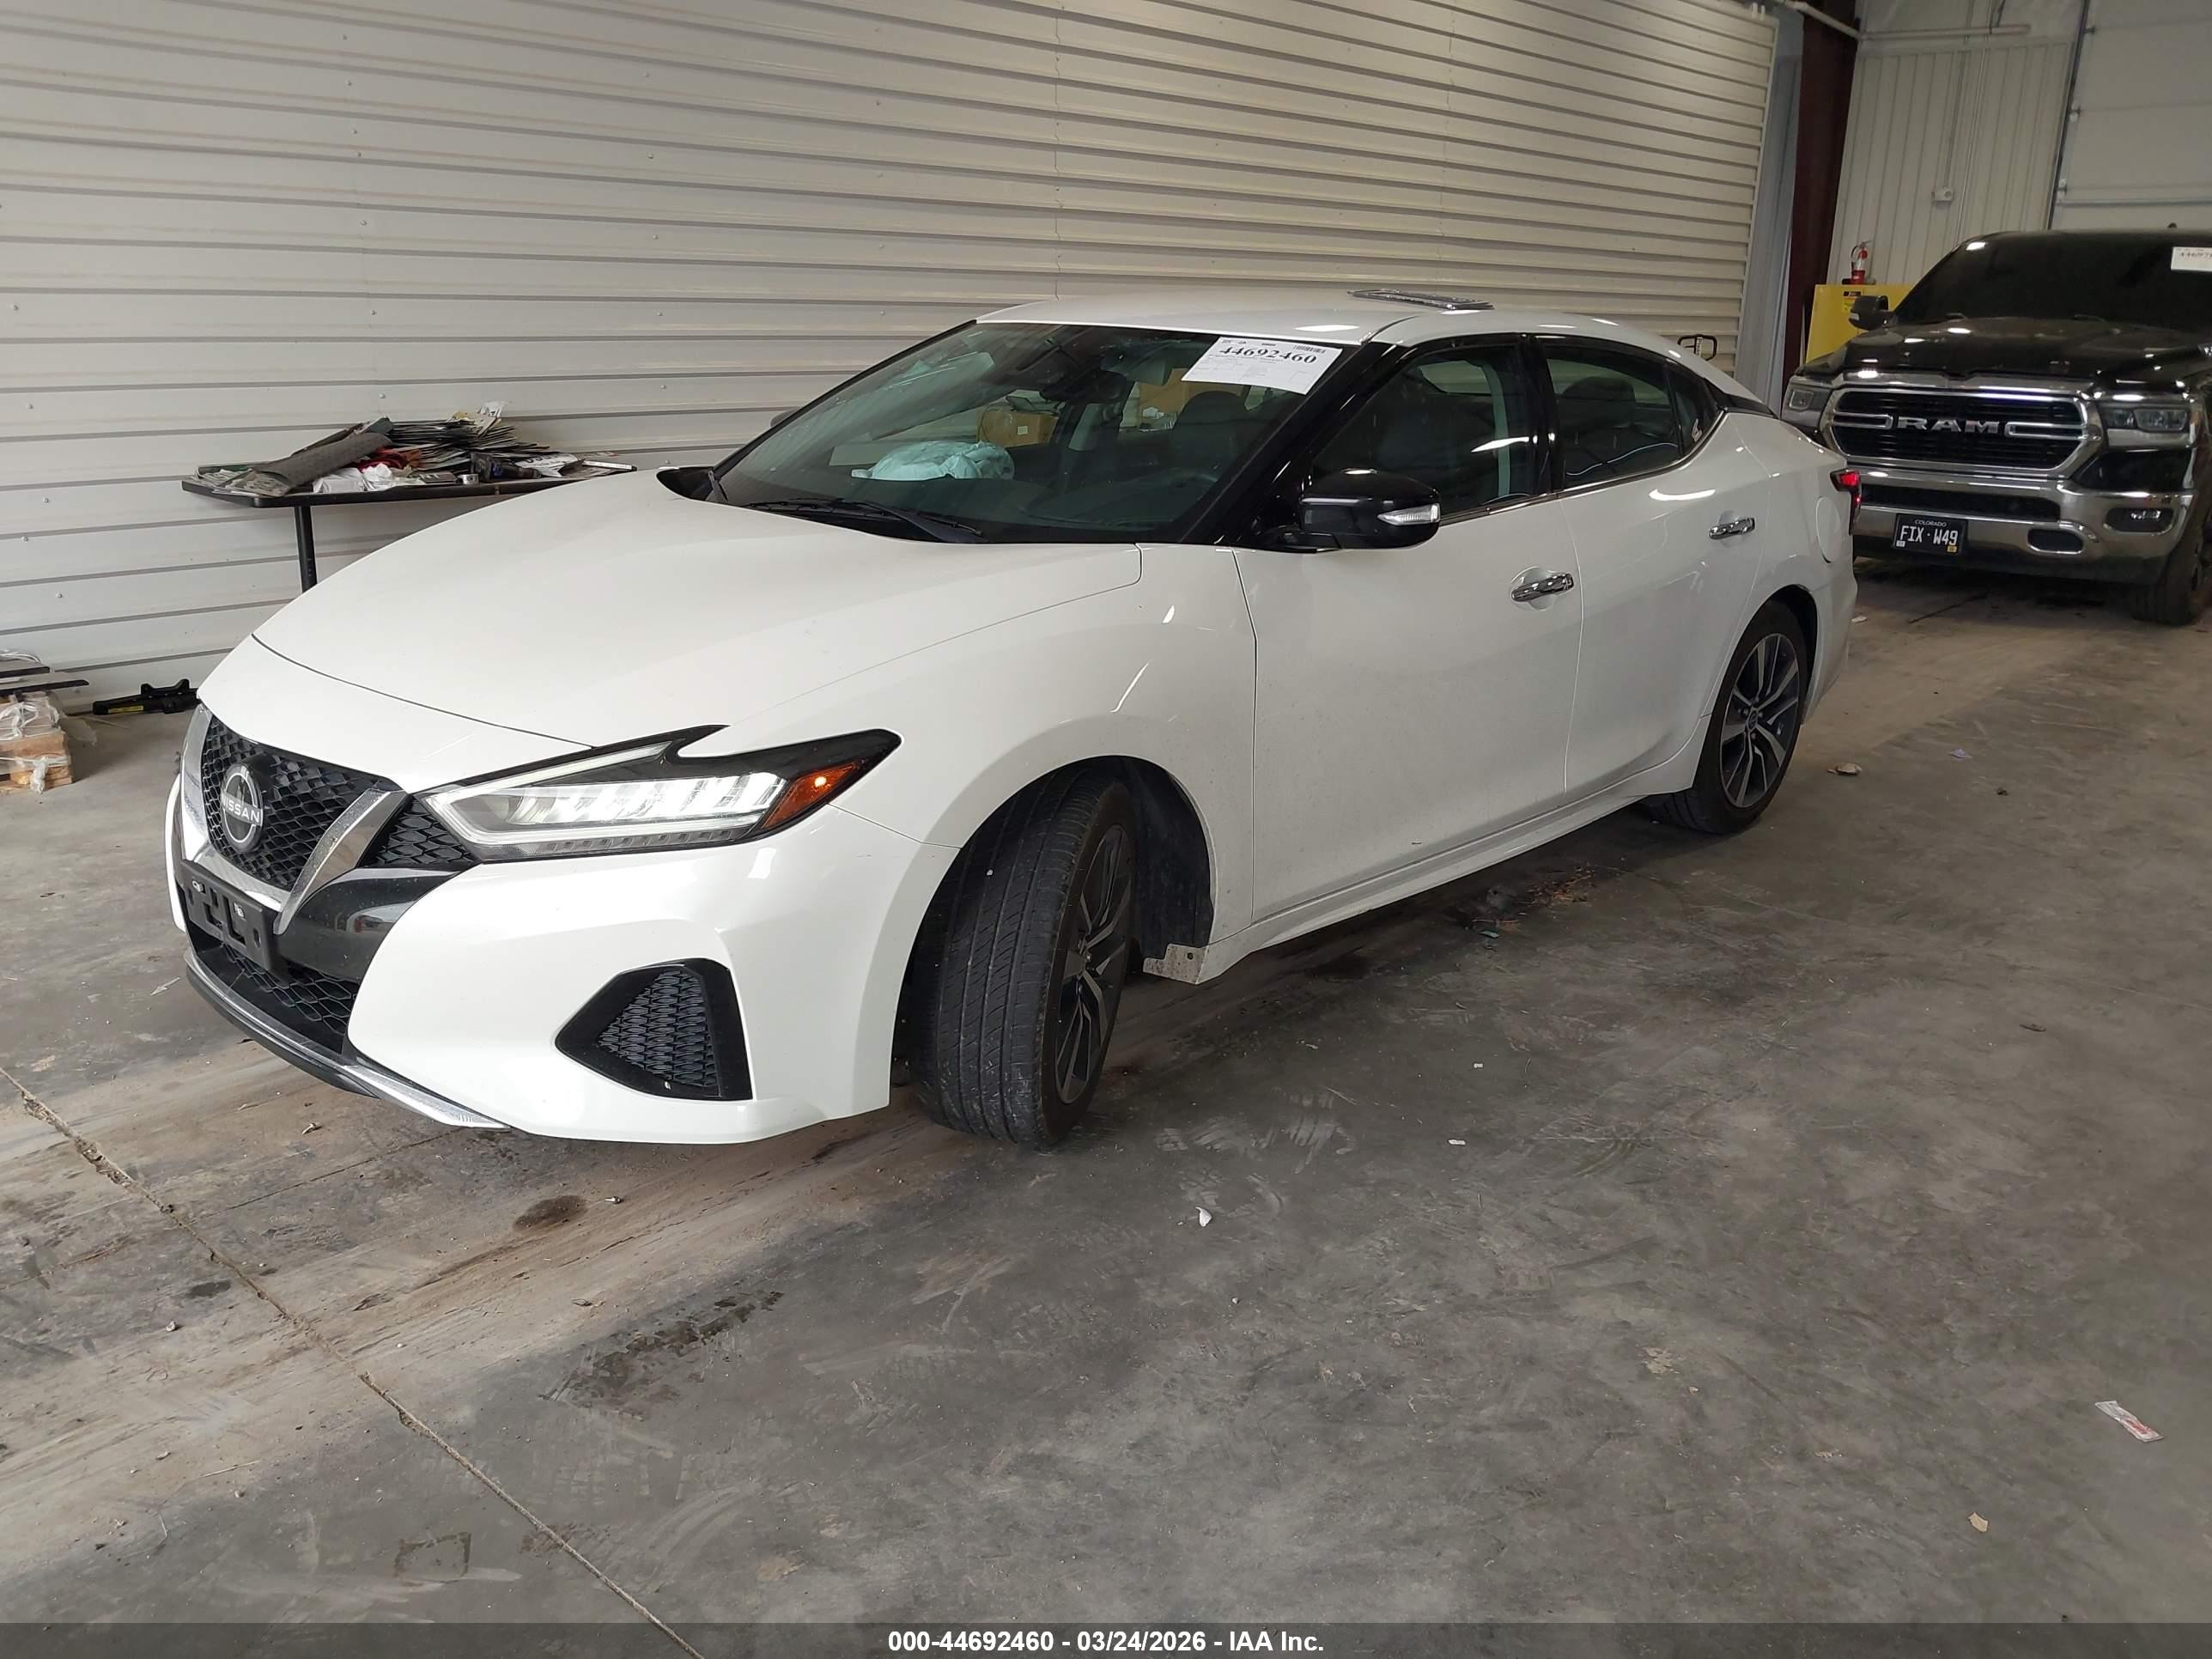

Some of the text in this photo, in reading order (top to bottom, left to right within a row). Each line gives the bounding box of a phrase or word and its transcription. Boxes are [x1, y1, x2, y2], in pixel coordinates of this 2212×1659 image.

[1219, 347, 1316, 363] 44692460
[1898, 416, 1999, 433] RAM
[1900, 526, 1923, 543] FIX
[1933, 528, 1958, 545] W49
[222, 794, 259, 823] NISSAN
